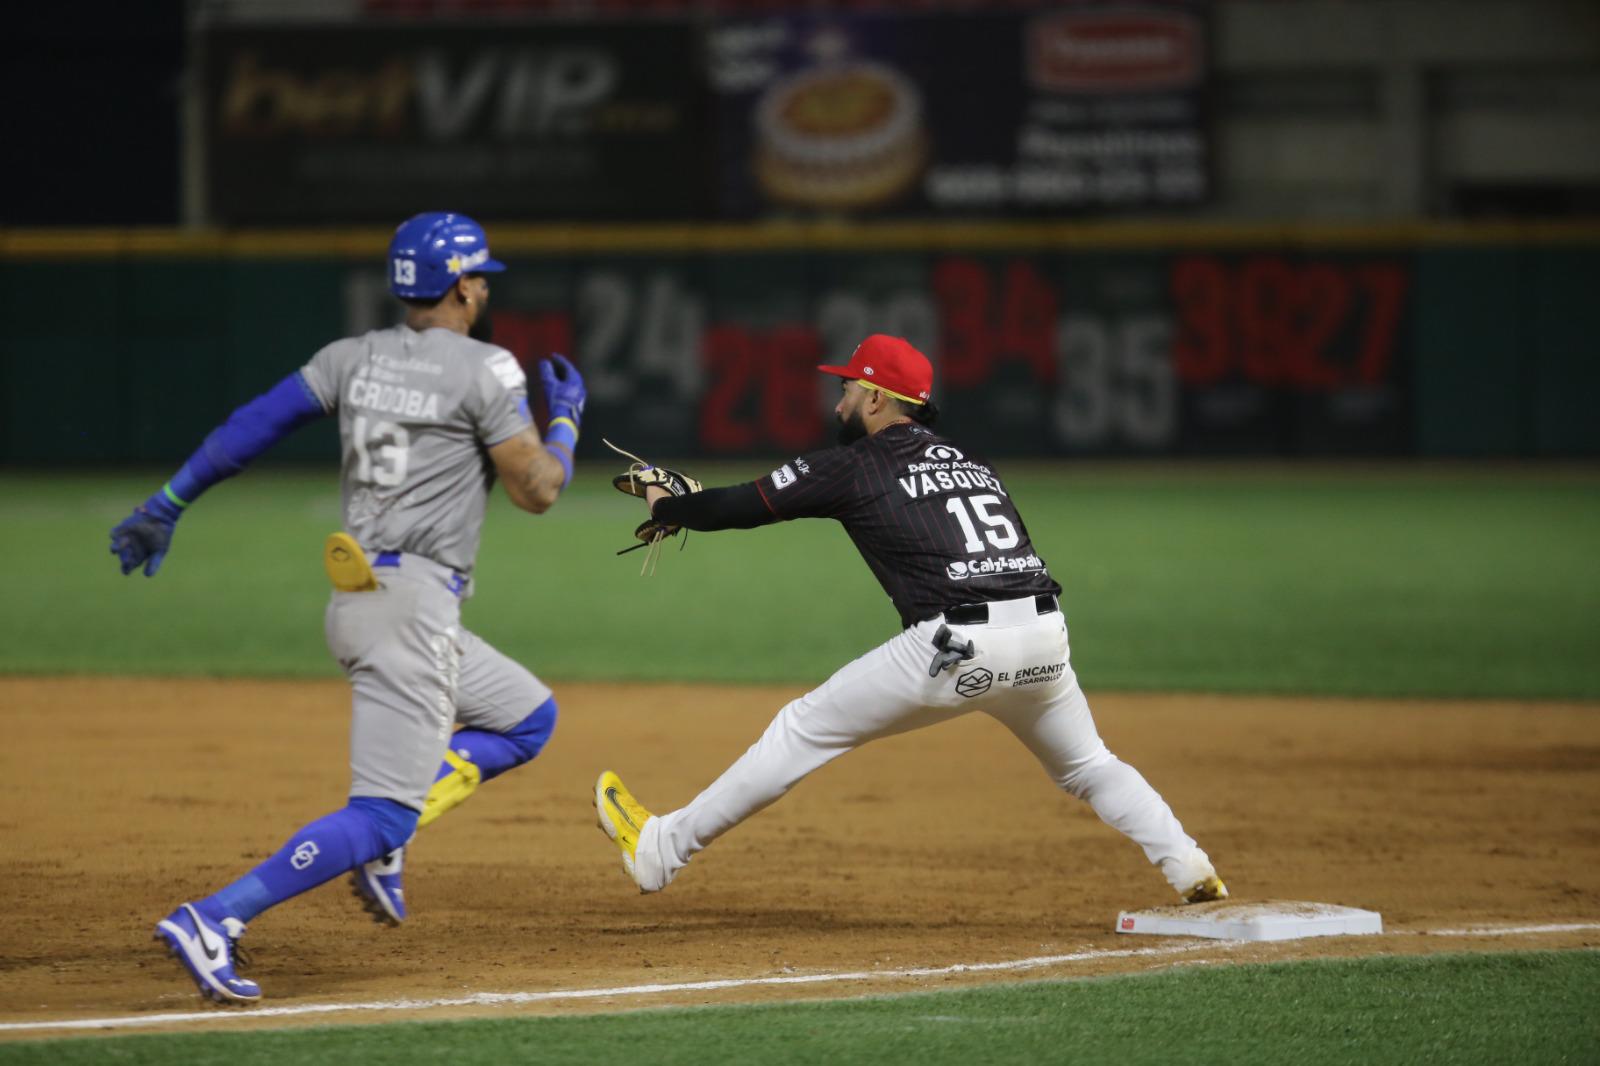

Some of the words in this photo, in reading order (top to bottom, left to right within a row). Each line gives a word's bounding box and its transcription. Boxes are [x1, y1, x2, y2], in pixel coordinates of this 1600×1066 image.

[394, 258, 416, 286] 13
[702, 322, 824, 452] 26
[1055, 310, 1178, 446] 35
[353, 416, 409, 487] 13
[899, 470, 1007, 498] VASQUEZ
[946, 494, 1019, 554] 15
[997, 672, 1010, 682] EL
[1014, 662, 1066, 681] ENCANTO
